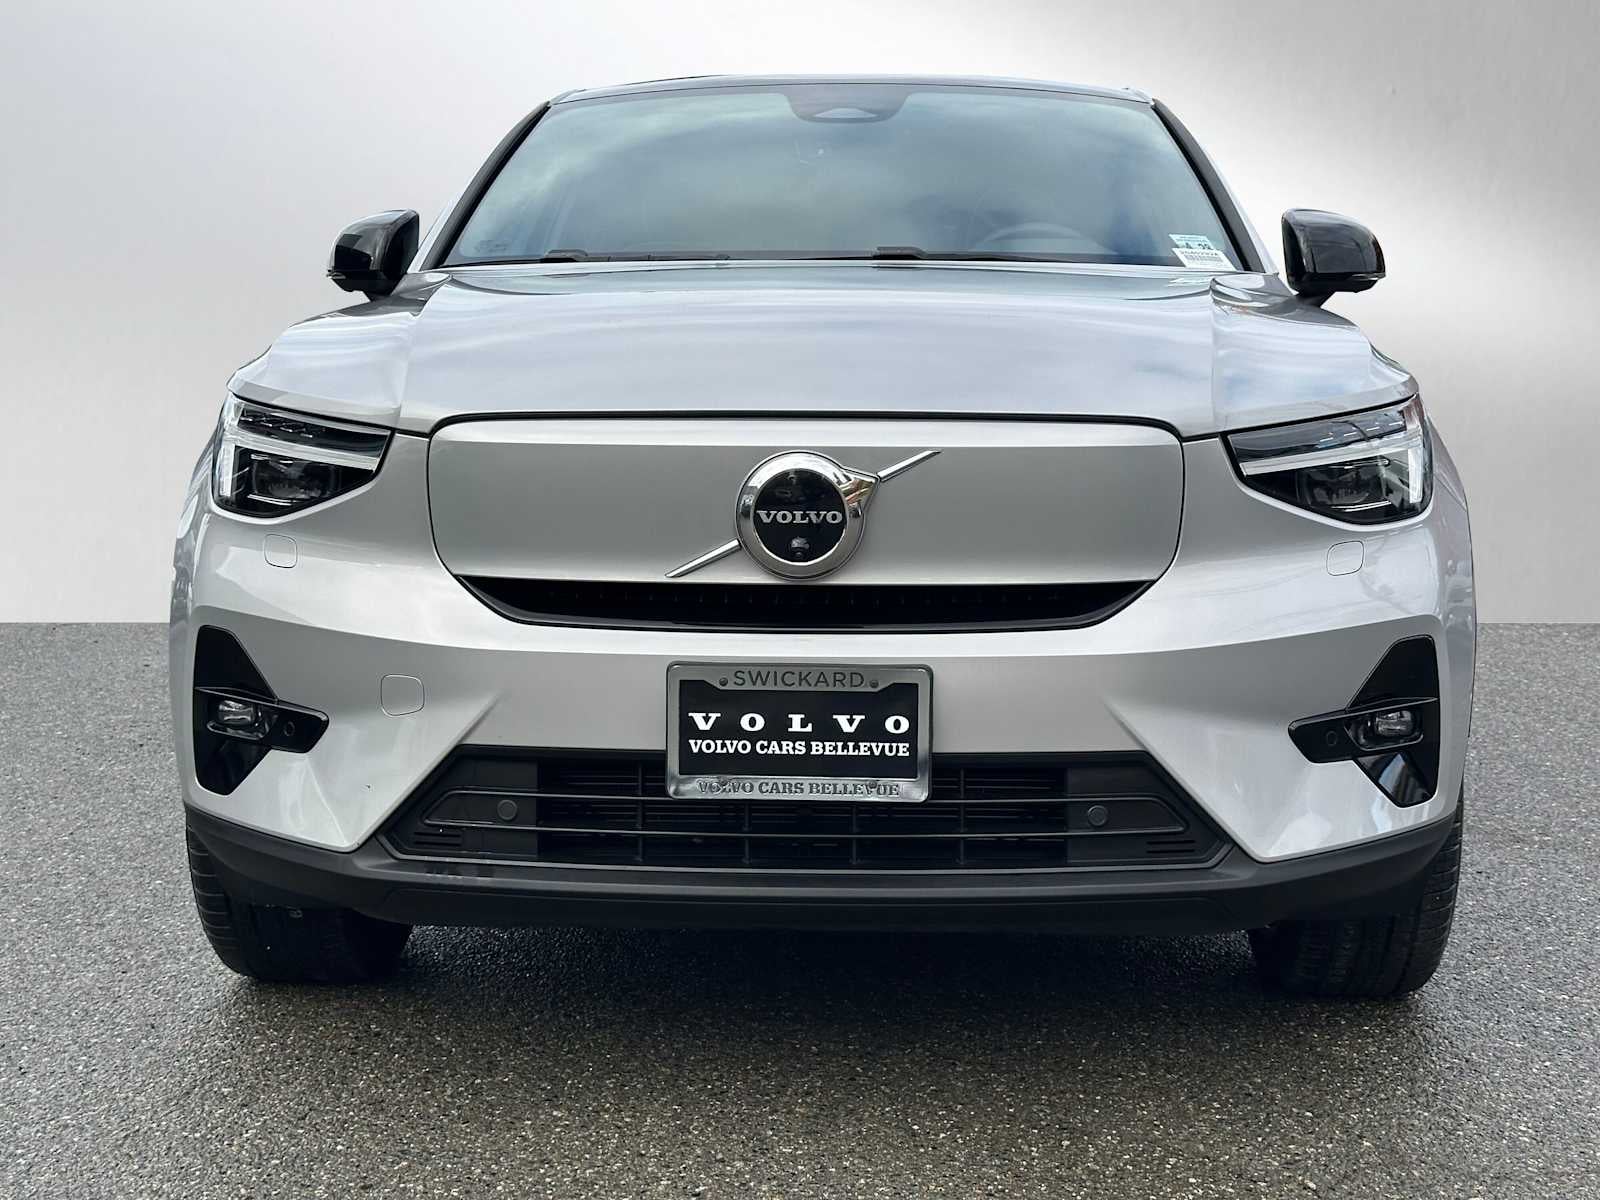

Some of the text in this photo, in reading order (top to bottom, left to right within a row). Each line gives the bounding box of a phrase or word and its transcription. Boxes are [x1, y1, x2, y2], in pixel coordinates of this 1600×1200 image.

[756, 510, 843, 524] VOLVO
[733, 670, 865, 689] SWICKARD
[688, 712, 910, 734] VOLVO
[688, 740, 910, 757] VOLVO CARS BELLEVUE
[758, 782, 804, 795] CARS
[808, 782, 899, 796] BELLEVUE
